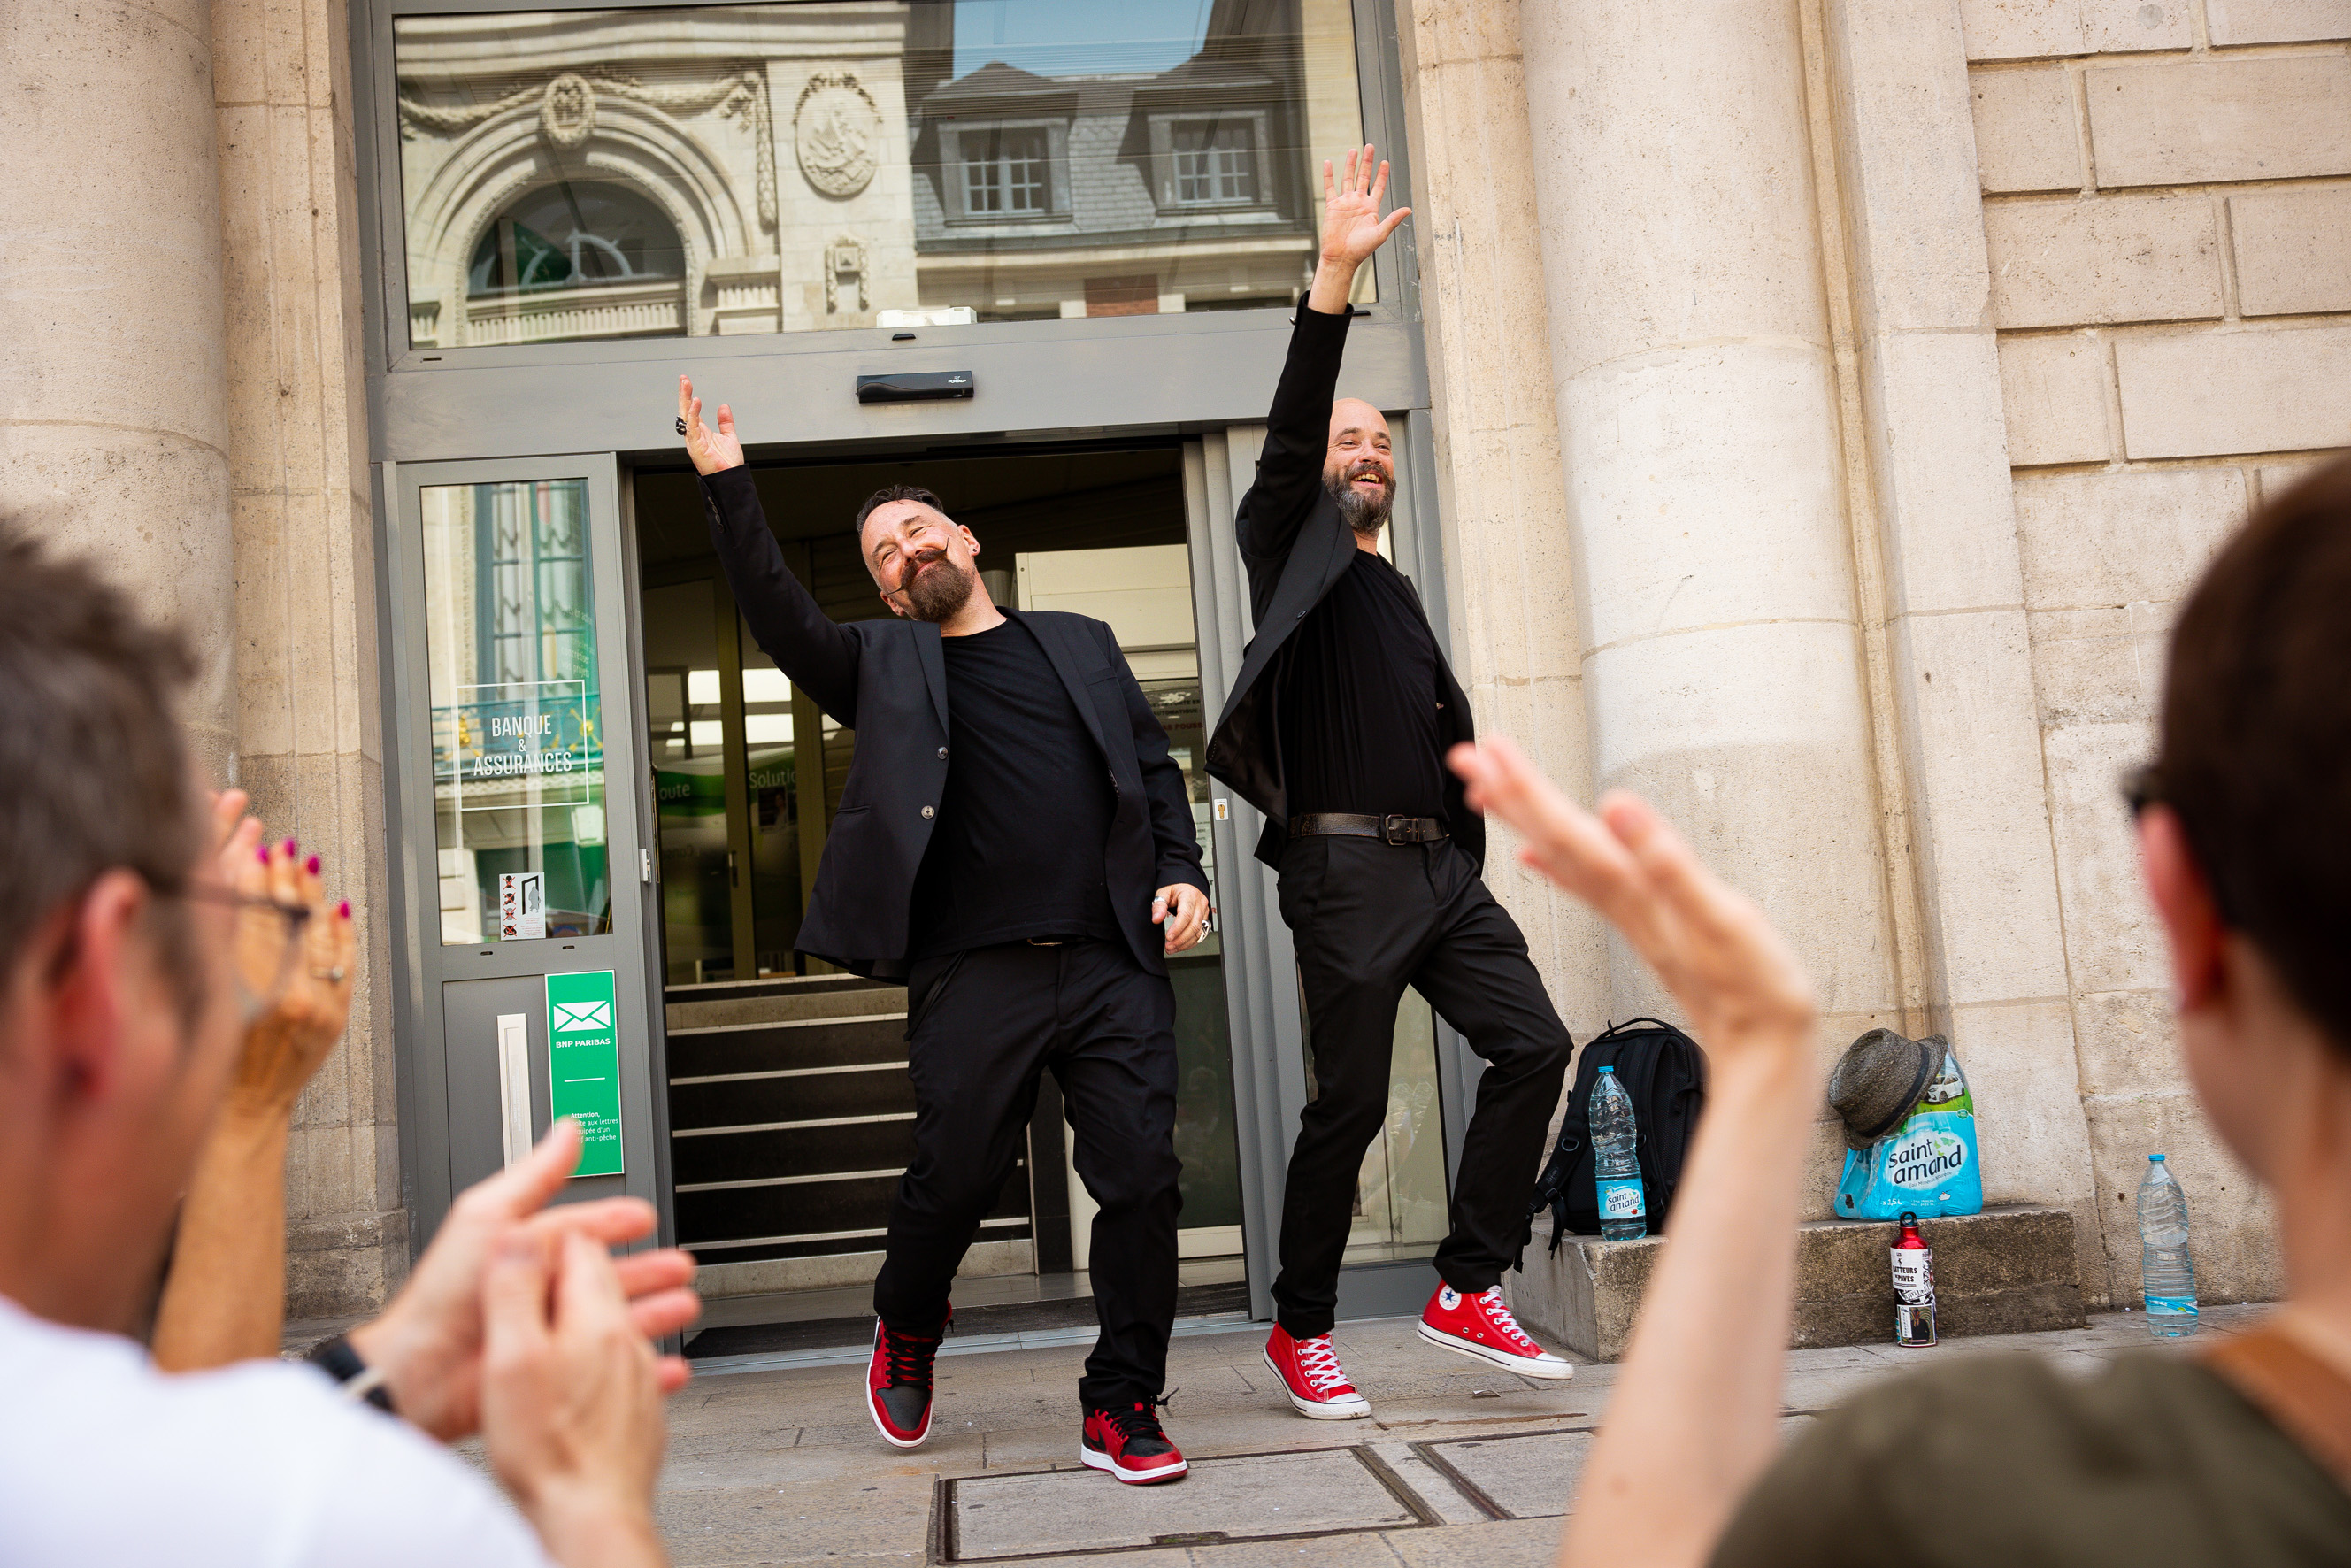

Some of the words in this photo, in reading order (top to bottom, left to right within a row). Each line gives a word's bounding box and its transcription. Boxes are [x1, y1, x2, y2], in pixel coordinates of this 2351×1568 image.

[491, 715, 552, 738] BANQUE
[518, 738, 526, 752] &
[473, 751, 572, 777] ASSURANCES
[575, 1038, 611, 1047] PARIBAS
[1888, 1139, 1932, 1169] saint
[1894, 1144, 1962, 1185] amand
[1608, 1192, 1626, 1204] saint
[1610, 1194, 1640, 1211] amand
